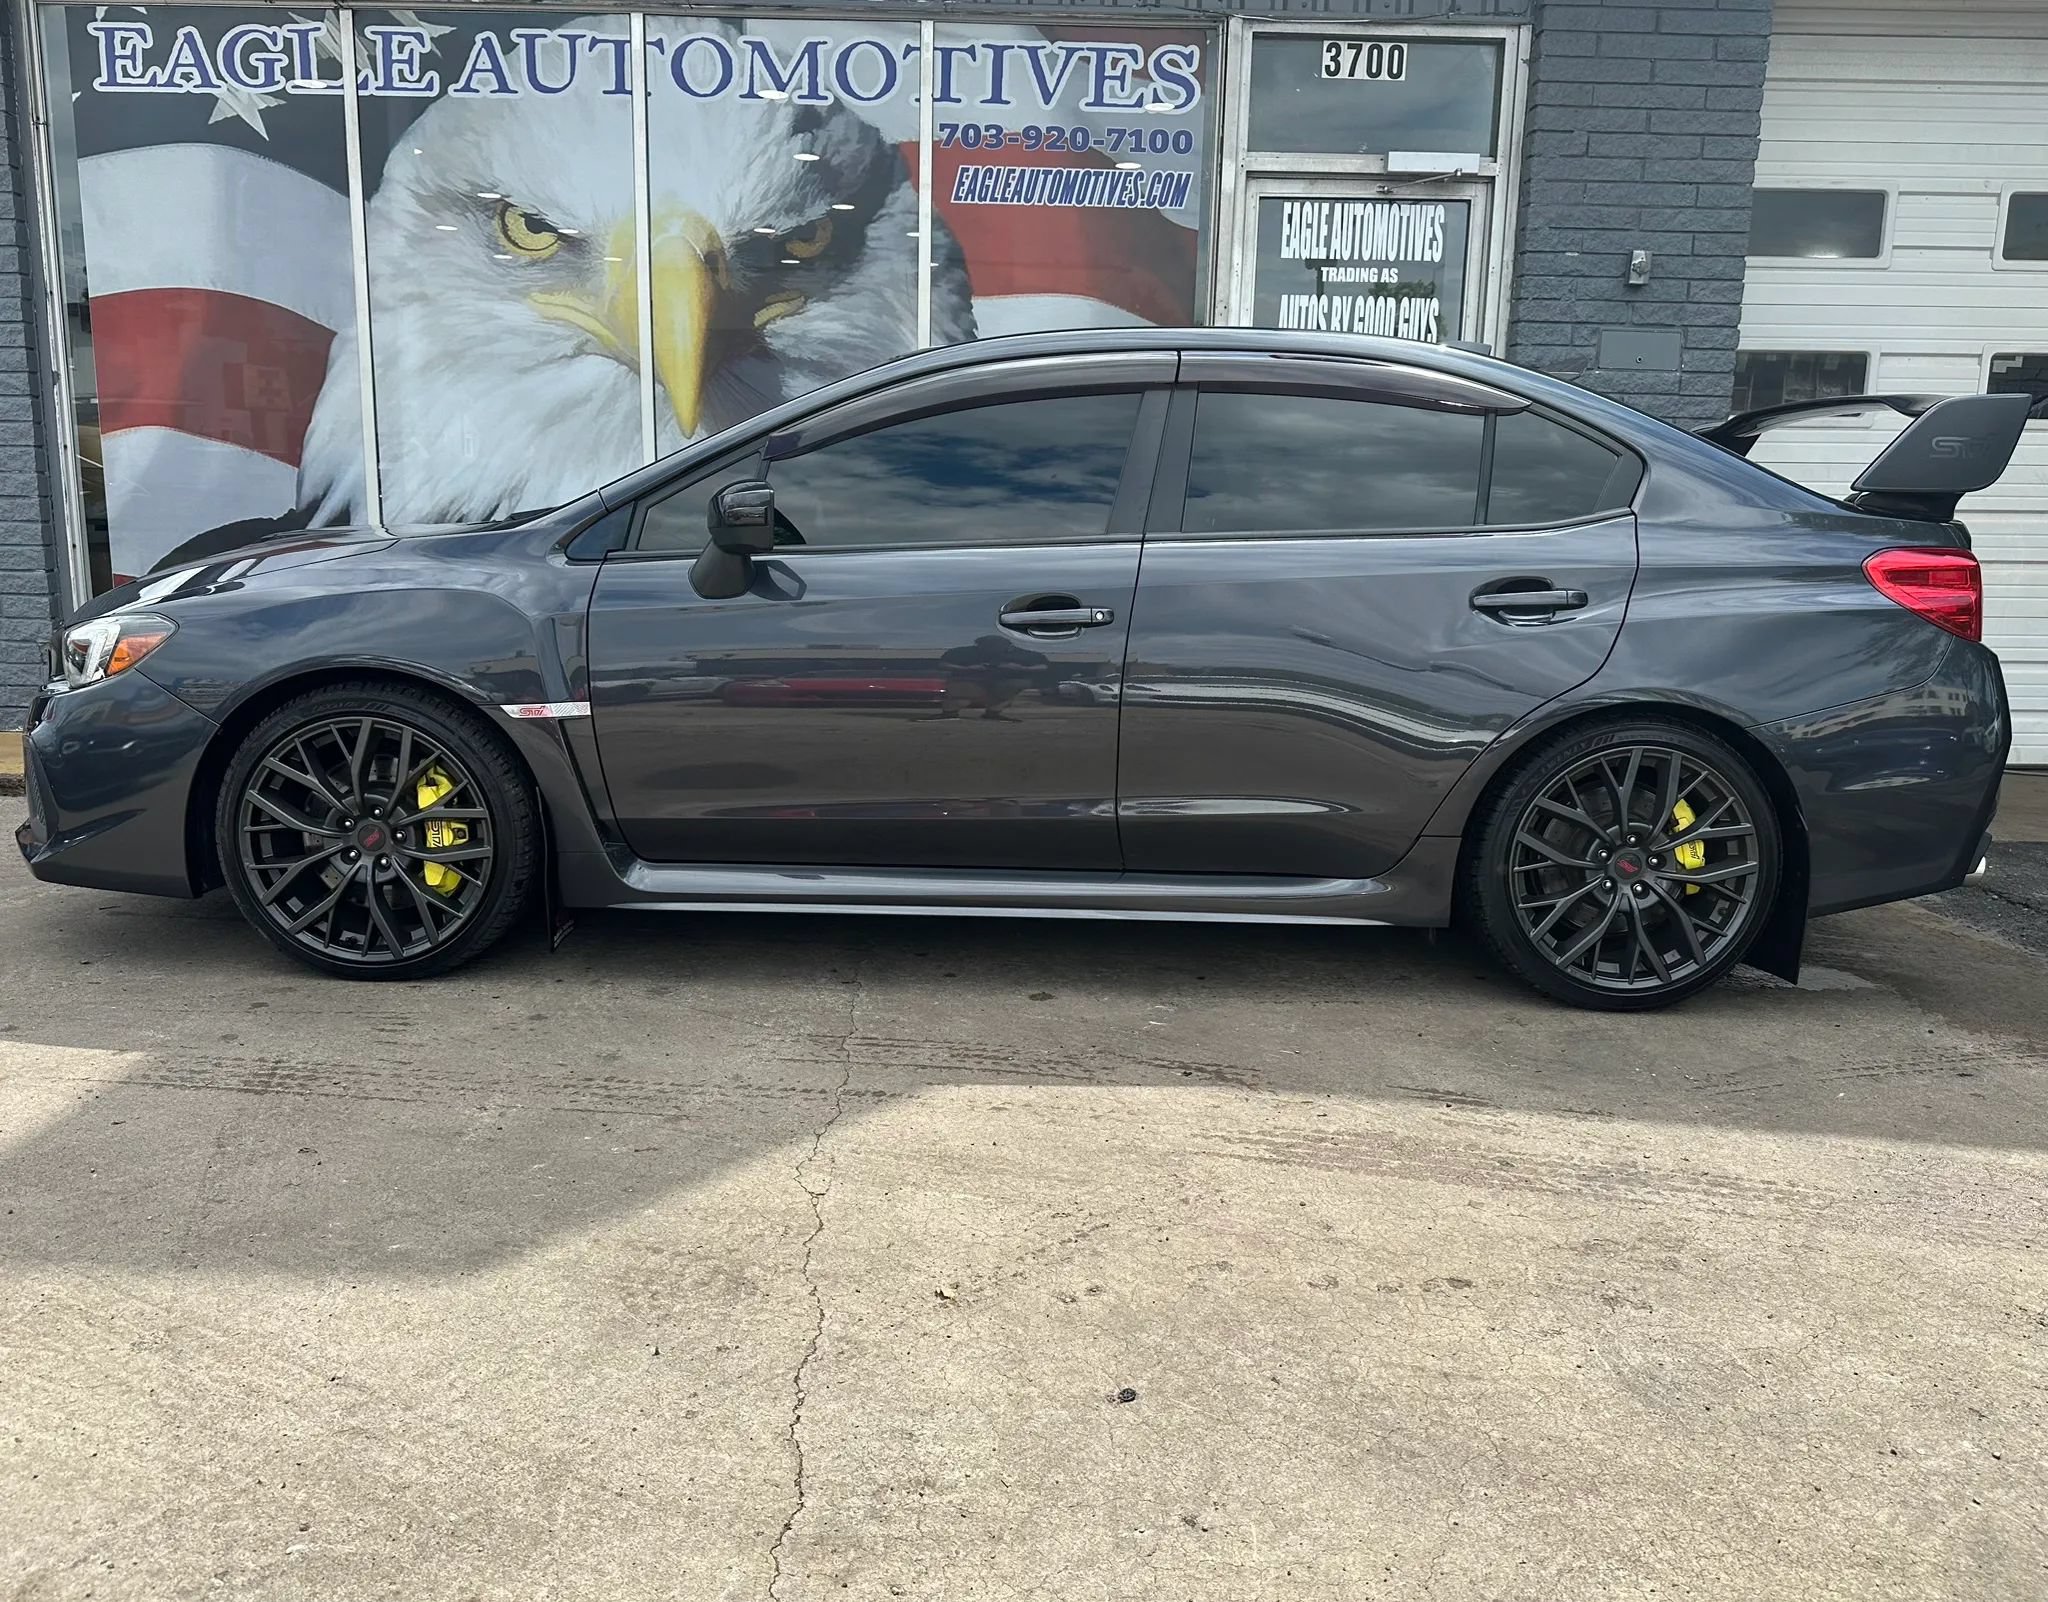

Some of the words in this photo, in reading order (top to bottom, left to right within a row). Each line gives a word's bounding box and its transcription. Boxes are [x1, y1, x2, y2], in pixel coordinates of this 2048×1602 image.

[88, 23, 439, 96] EAGLE
[449, 30, 1199, 112] AUTOMOTIVES
[1324, 41, 1405, 80] 3700
[938, 122, 1194, 154] 703-920-7100
[951, 165, 1194, 208] EAGLEAUTOMOTIVES.COM
[1280, 201, 1330, 260] EAGLE
[1329, 202, 1445, 263] AUTOMOTIVES
[1320, 266, 1378, 283] TRADING
[1380, 267, 1399, 283] AS
